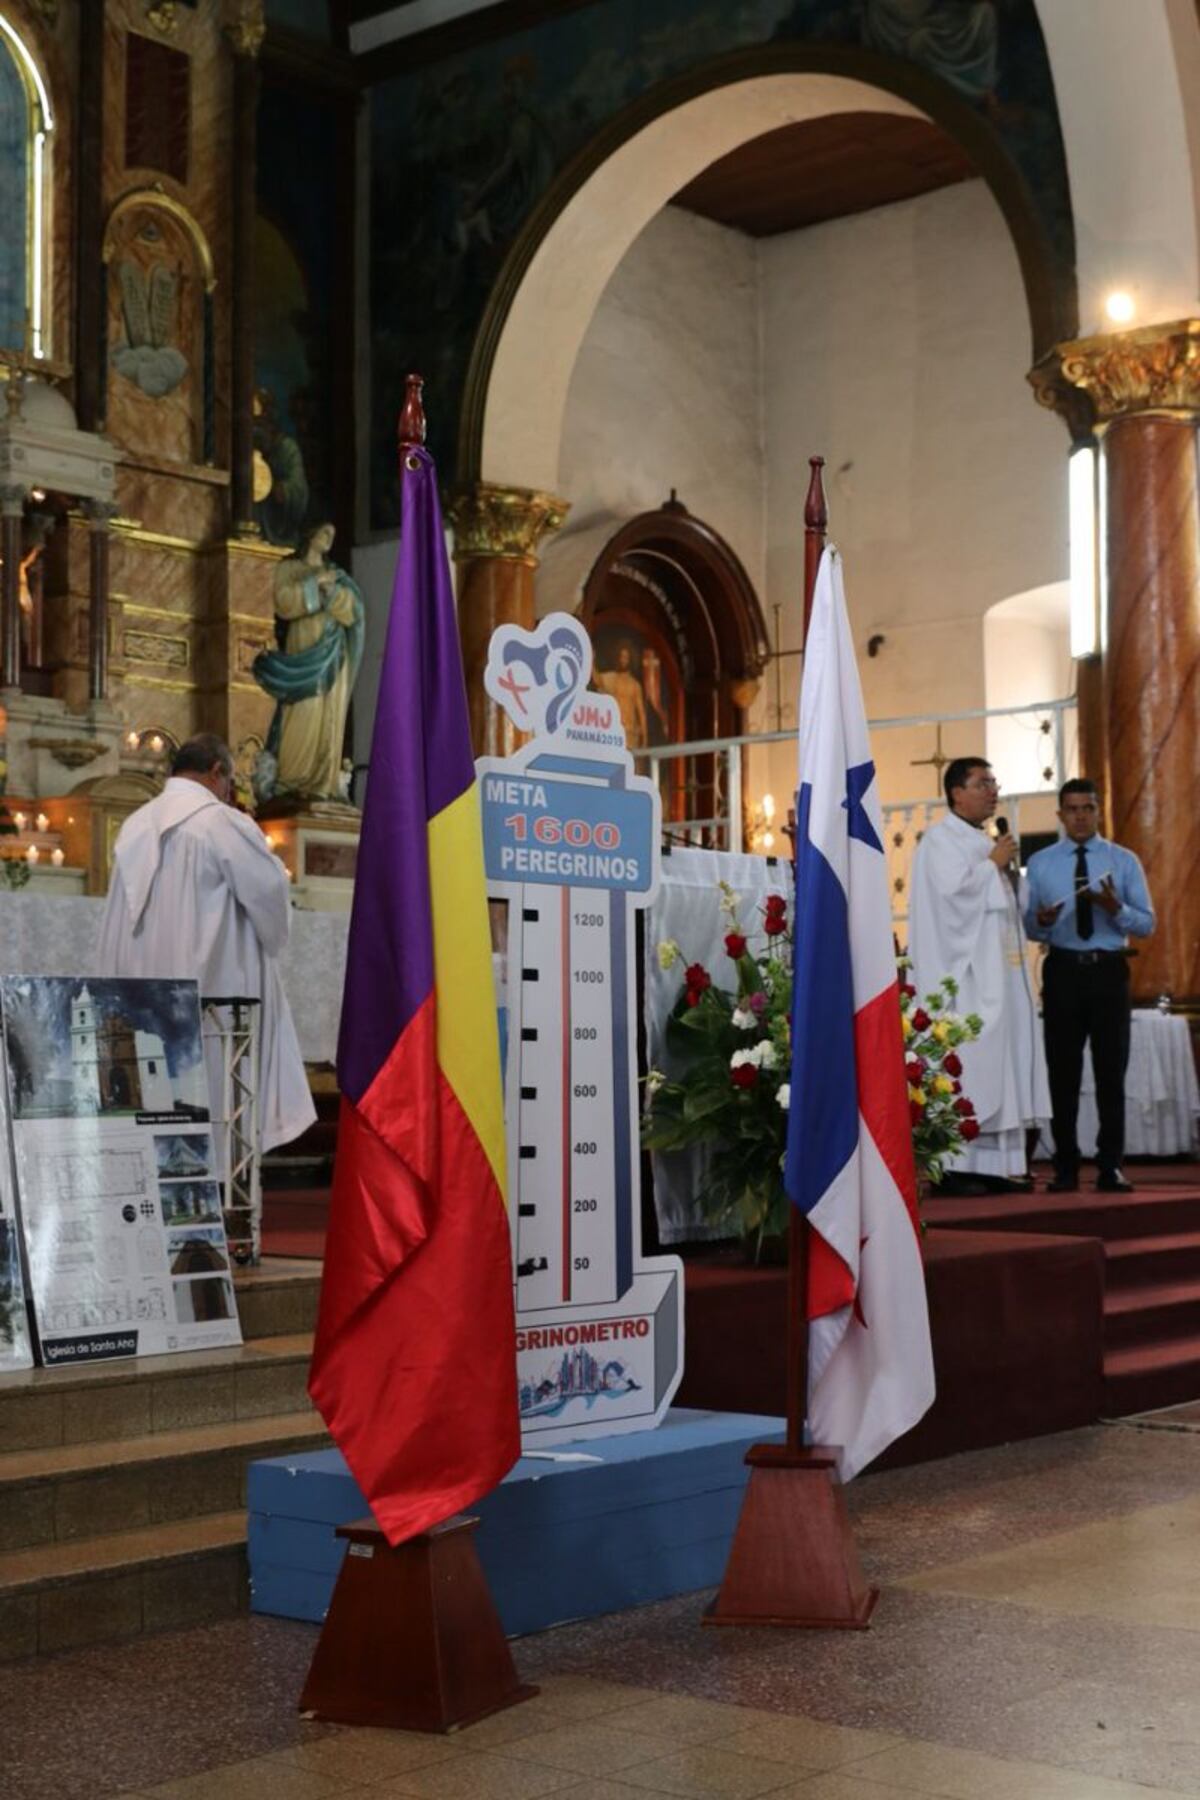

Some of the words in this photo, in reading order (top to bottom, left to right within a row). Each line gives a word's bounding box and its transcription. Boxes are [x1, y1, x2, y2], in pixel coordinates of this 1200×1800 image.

[573, 705, 612, 730] JMJ
[486, 779, 548, 808] META
[505, 813, 621, 850] 1600
[501, 847, 639, 881] PEREGRINOS
[574, 913, 604, 927] 1200
[574, 970, 604, 984] 1000
[574, 1027, 598, 1041] 800
[574, 1084, 597, 1098] 600
[574, 1142, 598, 1156] 400
[574, 1199, 598, 1213] 200
[574, 1257, 590, 1271] 50
[515, 1319, 649, 1351] GRINOMETRO
[77, 1343, 90, 1354] de
[90, 1340, 116, 1352] Santa
